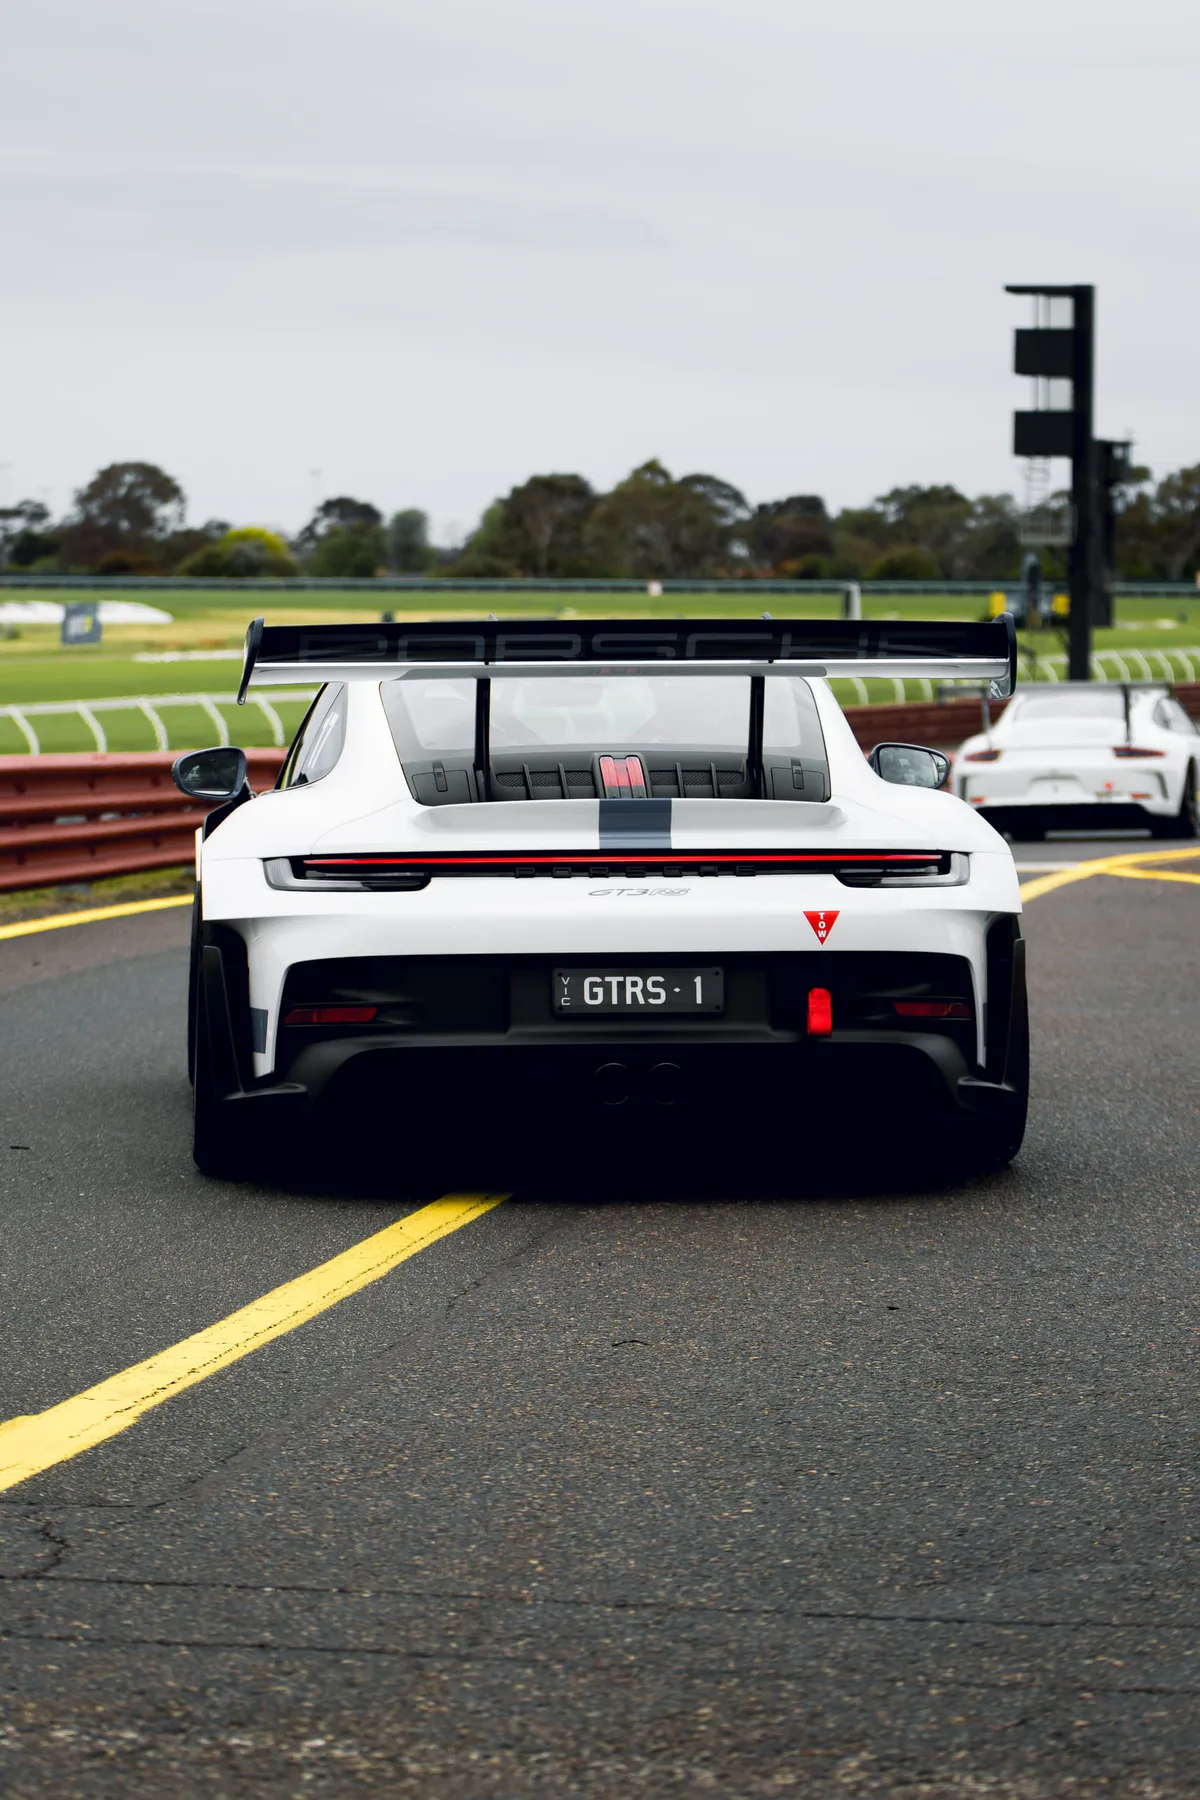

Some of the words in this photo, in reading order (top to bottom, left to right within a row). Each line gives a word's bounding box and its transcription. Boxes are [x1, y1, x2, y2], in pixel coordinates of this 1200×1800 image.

[817, 912, 827, 938] TOW
[561, 976, 571, 1006] VIC
[583, 976, 667, 1005] GTRS
